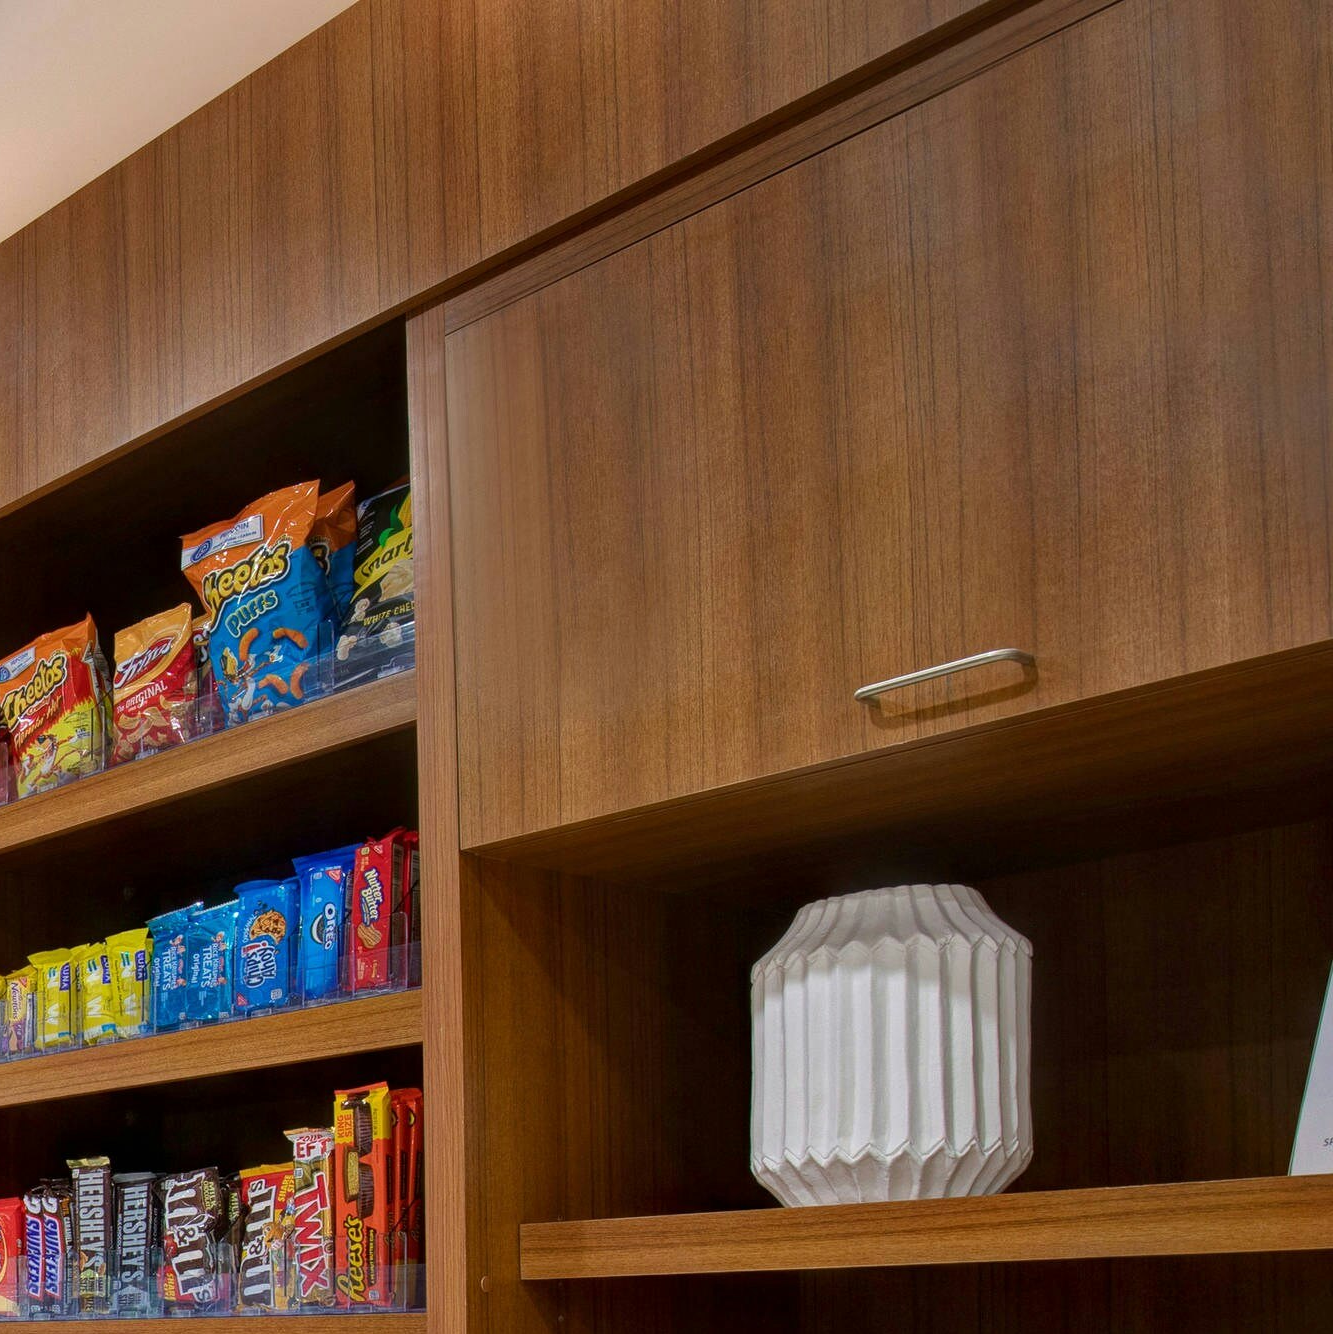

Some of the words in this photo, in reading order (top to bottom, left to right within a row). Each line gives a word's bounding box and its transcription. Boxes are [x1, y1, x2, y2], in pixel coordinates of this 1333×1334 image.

[225, 589, 279, 638] PUFFS
[363, 610, 391, 627] WHITE
[4, 654, 66, 729] Cheetos
[125, 680, 169, 710] ORIGINAL
[360, 887, 380, 921] Butter
[364, 868, 383, 904] Nutter
[325, 903, 336, 951] OREO
[61, 963, 70, 989] LUNA
[102, 956, 111, 983] LUNA
[137, 952, 147, 981] LUNA
[162, 950, 171, 991] TREATS
[201, 946, 211, 989] TREATS
[10, 982, 20, 1019] Newtons
[337, 1114, 345, 1138] KING
[344, 1113, 353, 1137] SIZE
[208, 1182, 218, 1208] MILK
[230, 1192, 239, 1224] MILK
[79, 1168, 106, 1270] HERSHEY'S
[121, 1184, 148, 1284] HERSHEY'S
[294, 1172, 330, 1298] TWIX
[26, 1215, 42, 1297] SNICKERS
[44, 1216, 62, 1295] SNICKERS
